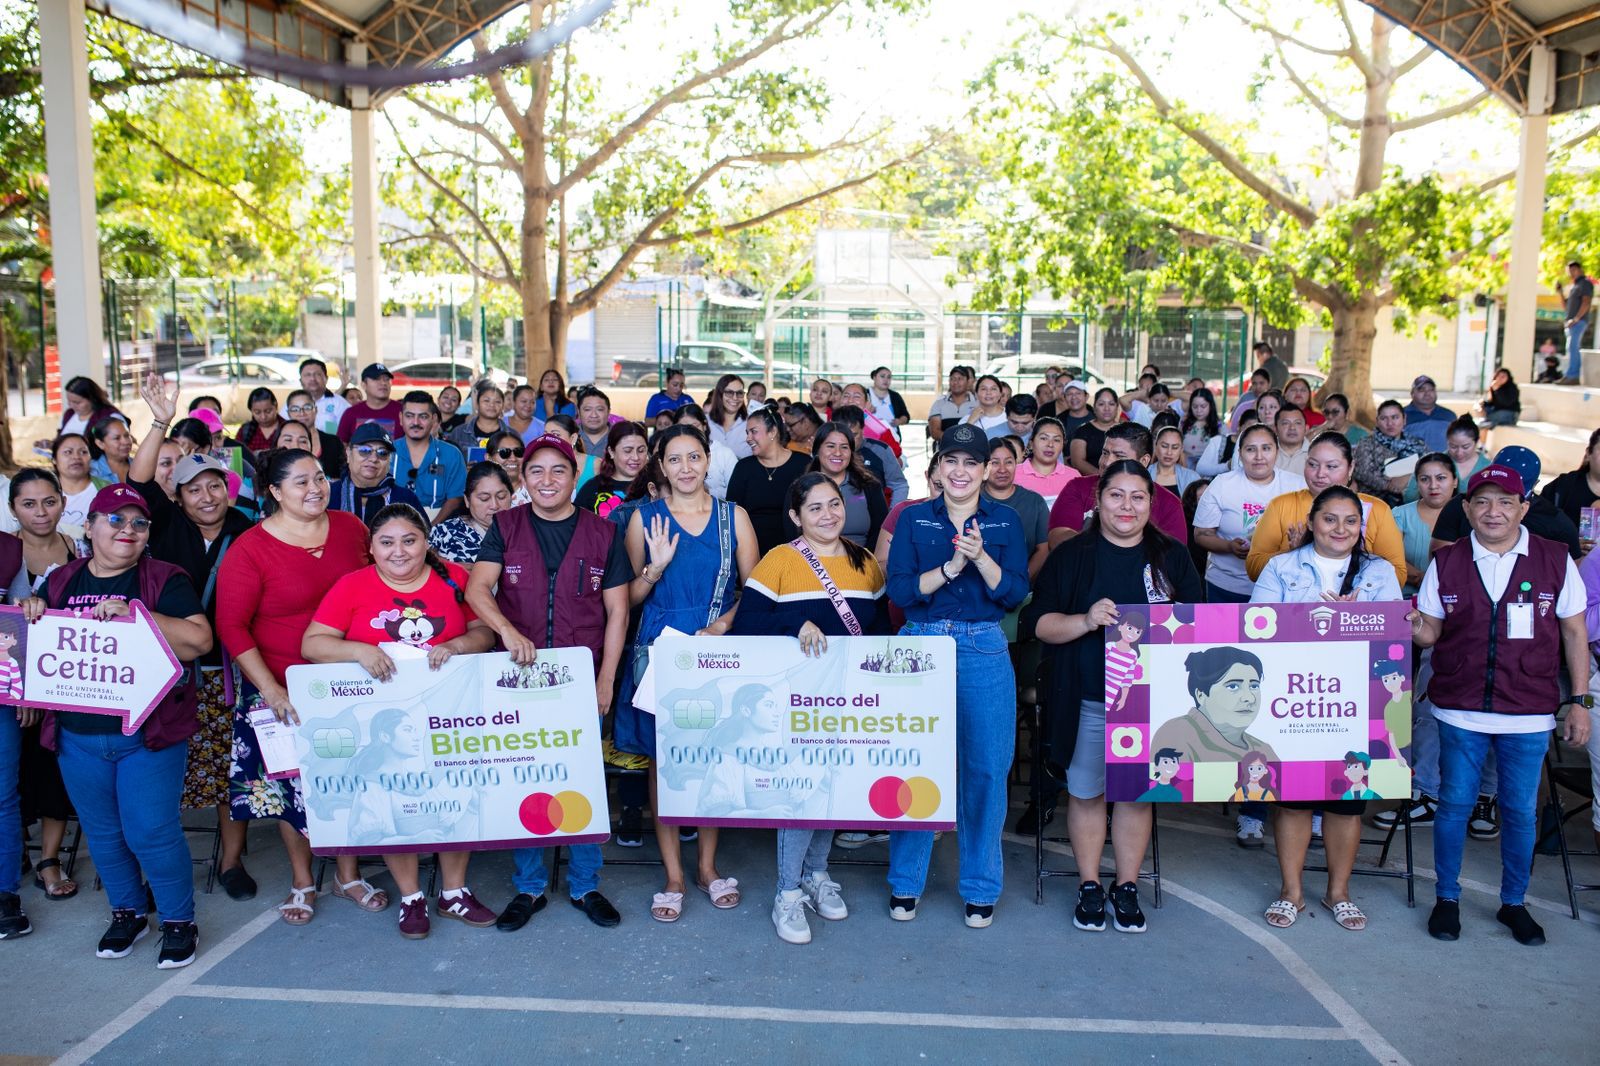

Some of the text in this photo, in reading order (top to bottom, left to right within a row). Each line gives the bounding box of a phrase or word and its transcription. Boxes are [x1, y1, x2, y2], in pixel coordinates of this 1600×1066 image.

[825, 581, 843, 608] LOLA
[1340, 612, 1384, 624] Becas
[57, 626, 118, 655] Rita
[37, 653, 135, 685] Cetina
[698, 659, 740, 669] México
[76, 686, 114, 694] UNIVERSAL
[329, 679, 363, 687] Gobierno
[330, 685, 374, 698] México
[1287, 672, 1341, 694] Rita
[57, 691, 96, 699] EDUCACIÓN
[790, 694, 880, 707] Banco del
[1270, 696, 1357, 719] Cetina
[429, 710, 520, 730] Banco del
[790, 710, 940, 733] Bienestar
[431, 726, 583, 756] Bienestar
[493, 755, 535, 764] mexicanos
[671, 746, 921, 766] 0000 0000 0000 0000
[315, 763, 568, 794] 0000 0000 0000 0000
